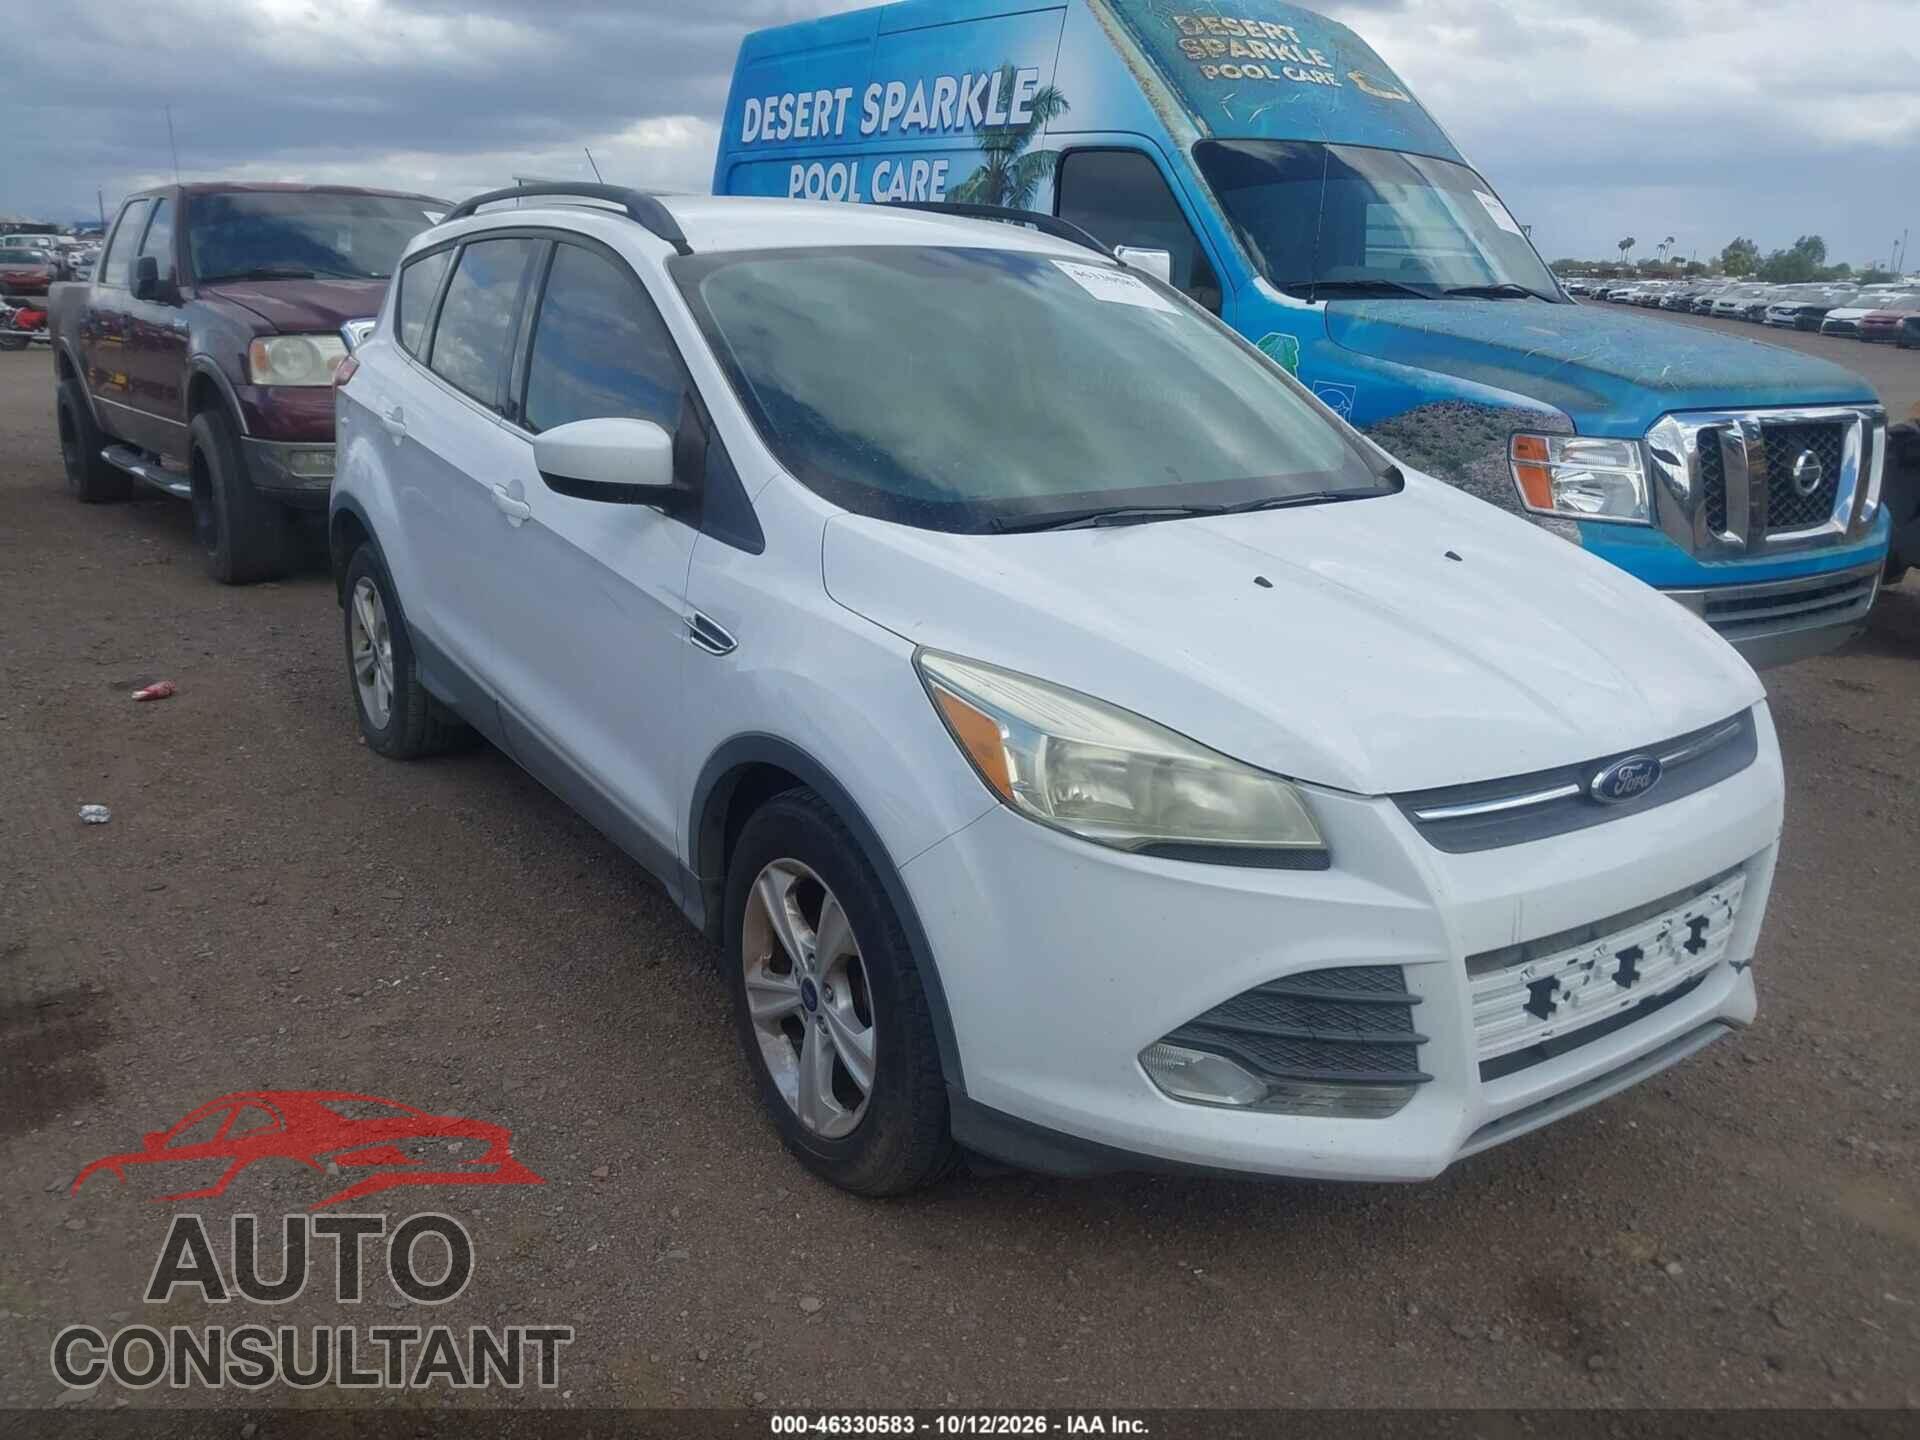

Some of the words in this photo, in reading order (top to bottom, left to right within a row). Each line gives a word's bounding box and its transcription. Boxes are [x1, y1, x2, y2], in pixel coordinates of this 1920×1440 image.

[1173, 15, 1302, 44] DESERT
[1178, 38, 1333, 68] SPARKLE
[1201, 63, 1280, 81] POOL
[1283, 65, 1342, 87] CARE
[742, 87, 853, 144] DESERT
[860, 67, 1039, 136] SPARKLE
[788, 161, 861, 202] POOL
[871, 159, 949, 203] CARE
[1614, 763, 1653, 796] Ford
